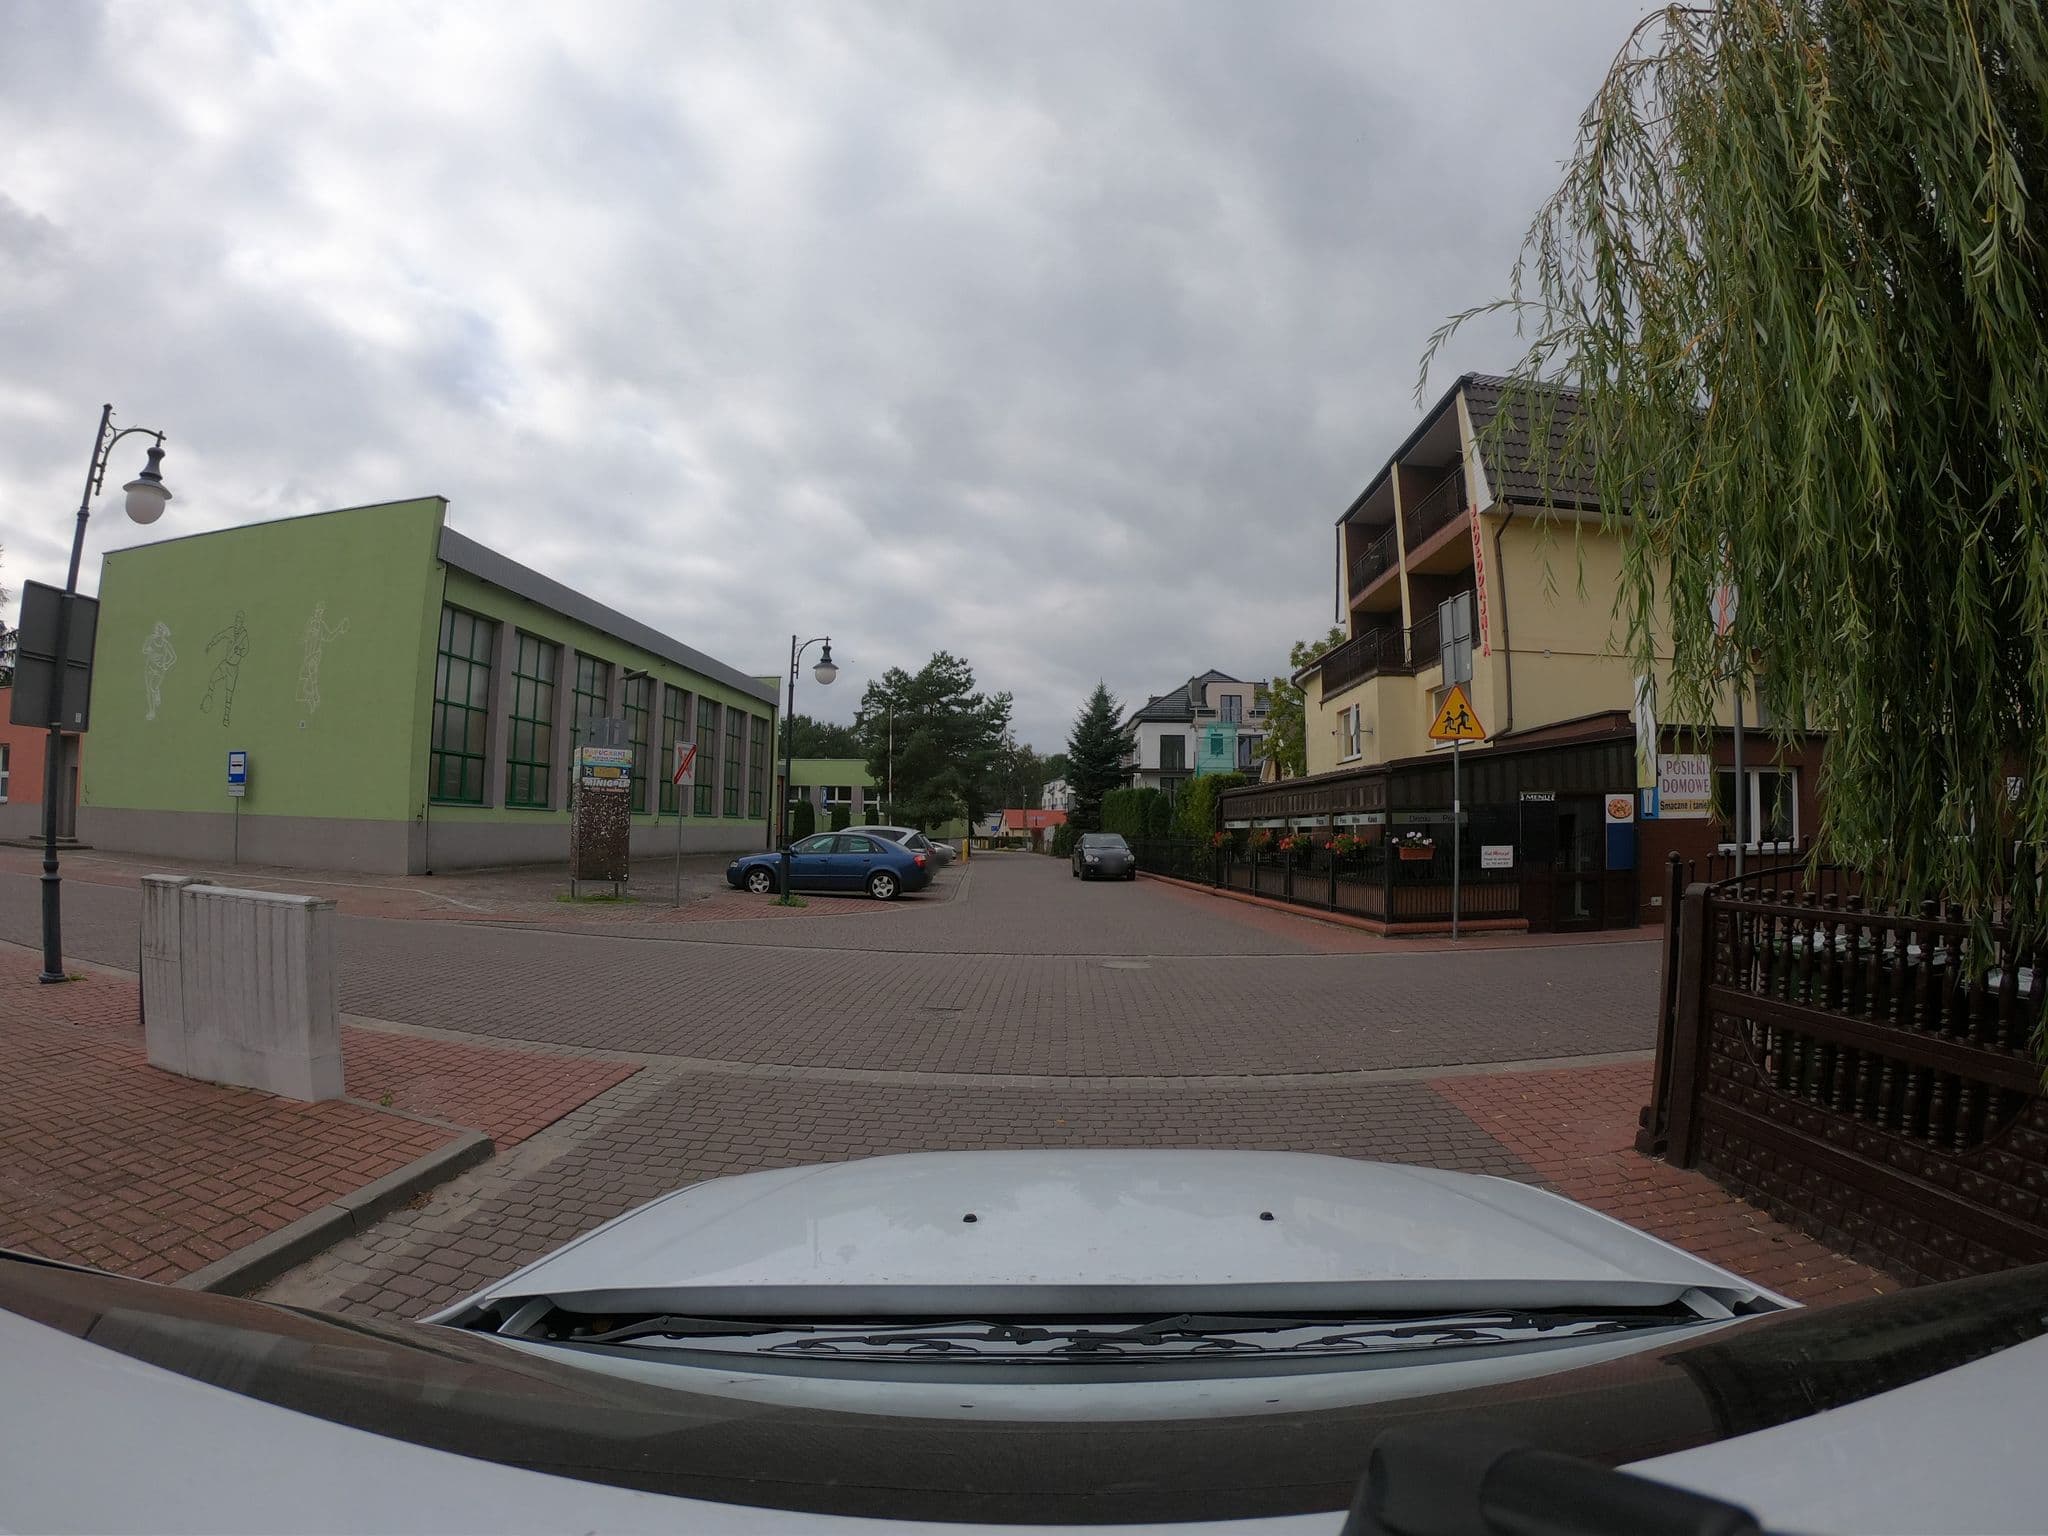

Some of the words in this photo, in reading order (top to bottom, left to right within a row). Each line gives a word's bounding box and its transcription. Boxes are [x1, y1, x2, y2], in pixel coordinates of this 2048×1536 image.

[1666, 760, 1706, 775] POSIŁKI
[1662, 779, 1710, 793] DOMOWE
[1660, 800, 1689, 811] Smaczne
